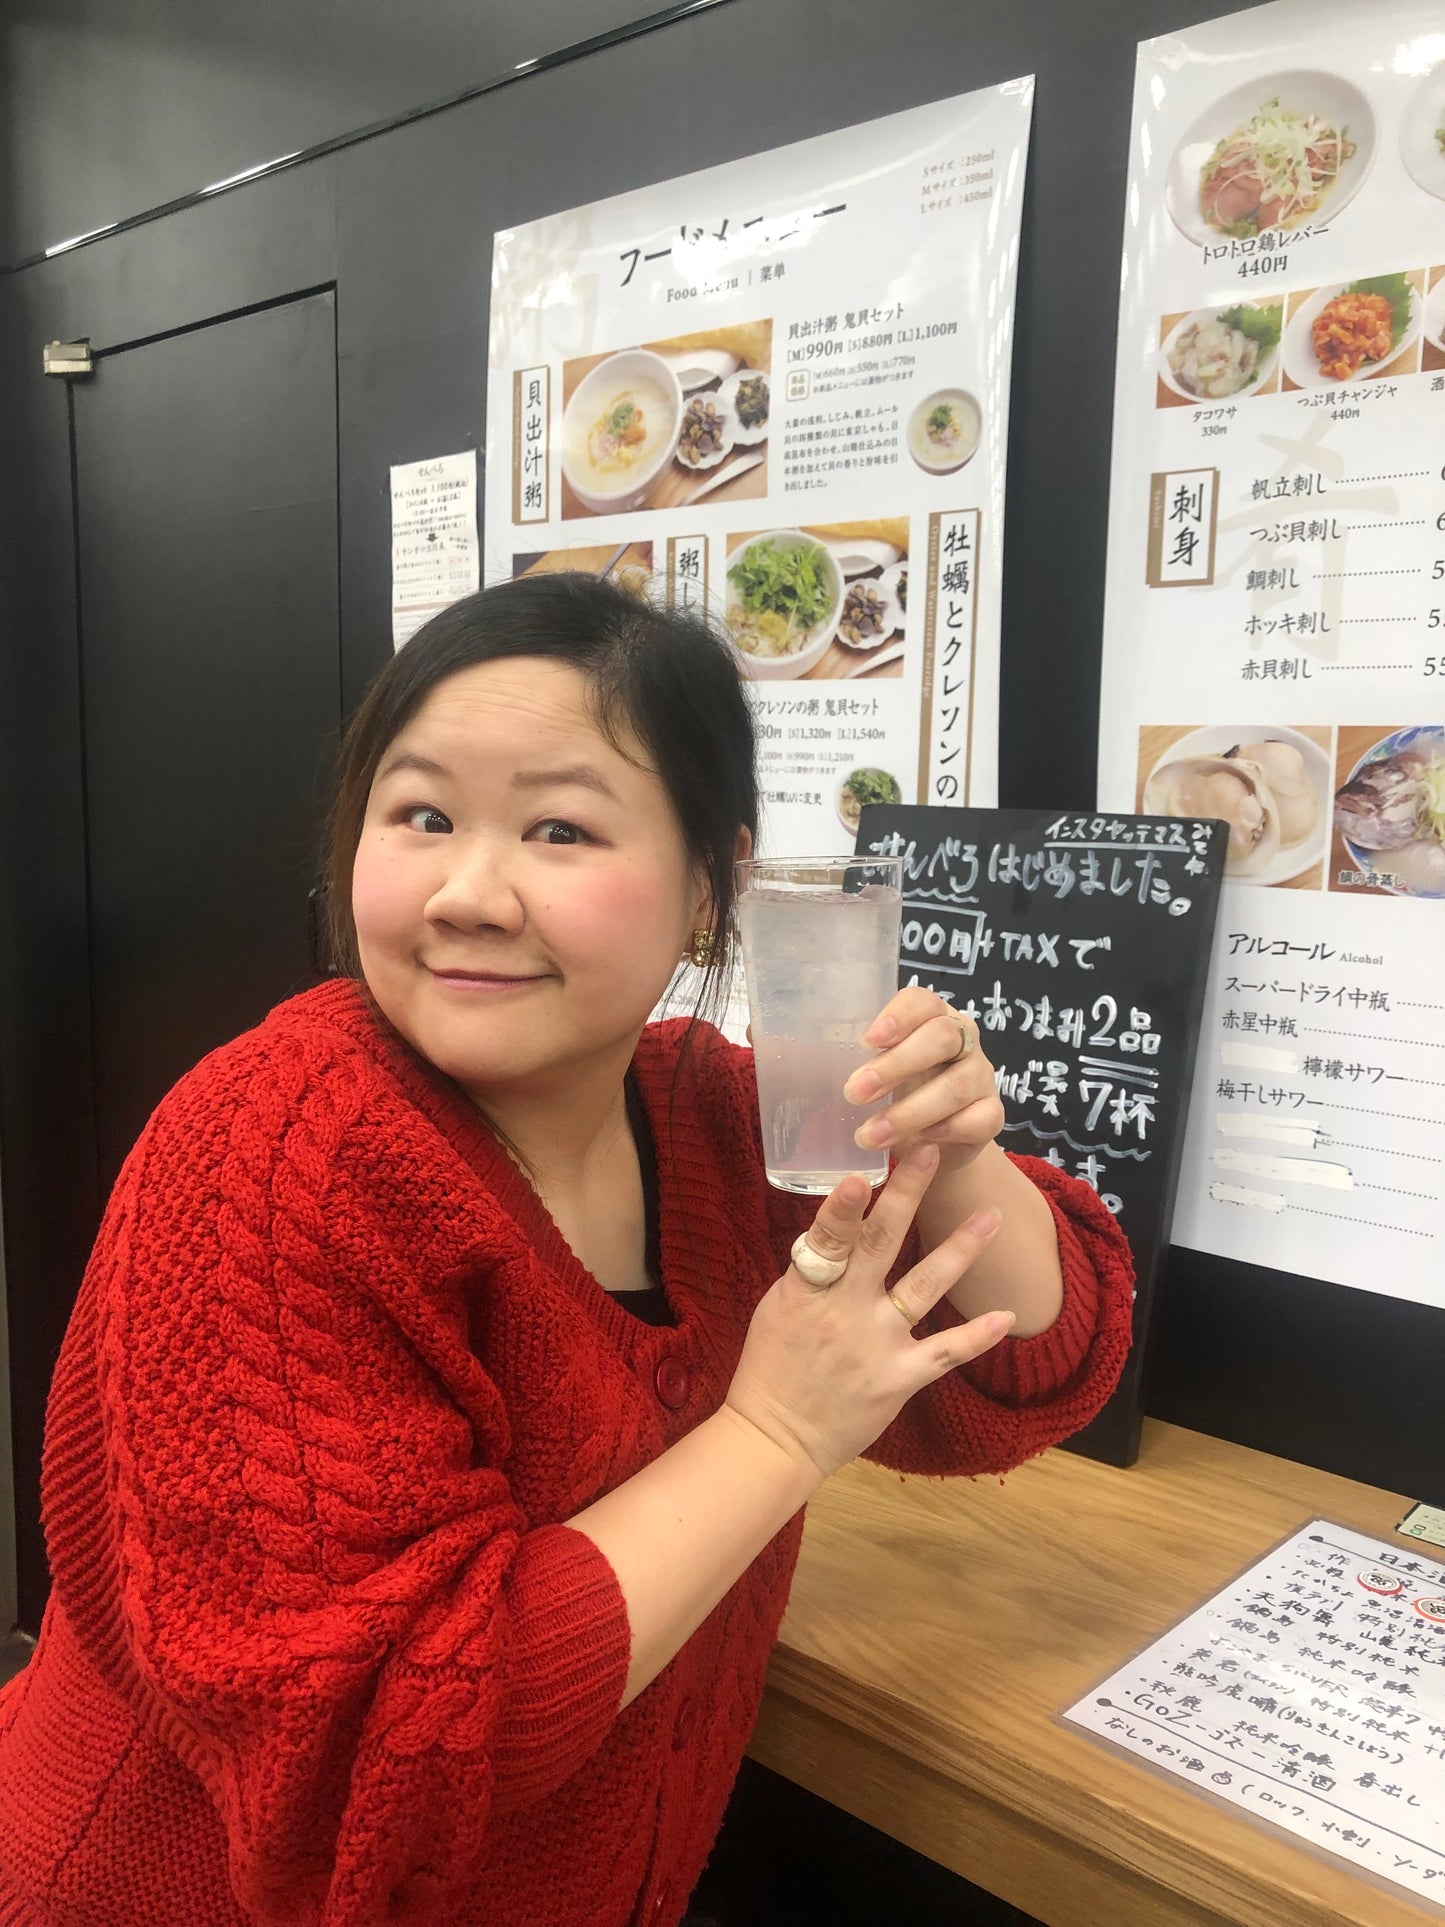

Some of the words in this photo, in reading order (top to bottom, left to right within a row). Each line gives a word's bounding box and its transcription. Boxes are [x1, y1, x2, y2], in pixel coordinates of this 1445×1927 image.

[1203, 225, 1330, 265] トロトロ鶏レバー
[1237, 254, 1288, 278] 440円
[702, 277, 739, 296] nu
[787, 315, 838, 341] 貝出汁粥
[843, 302, 905, 331] 鬼貝セット
[1297, 384, 1398, 408] つぶ貝チャンジャ
[1192, 406, 1238, 424] タコワサ
[1330, 408, 1360, 421] 440円
[523, 379, 543, 509] 貝出汁粥
[1201, 425, 1228, 438] 330円
[1250, 472, 1328, 501] 帆立刺し
[1166, 482, 1205, 567] 刺身
[1249, 517, 1343, 544] つぶ貝刺し
[1245, 567, 1301, 592] 鯛刺し
[1244, 611, 1332, 636] ホッキ刺し
[1241, 656, 1313, 681] 赤貝刺し
[824, 697, 879, 717] 鬼貝セット
[754, 724, 782, 740] 30円
[1228, 932, 1336, 962] アルコール
[1338, 952, 1384, 966] Alcohol
[1224, 974, 1391, 1013] スーパードライ中瓶
[1221, 1009, 1299, 1038] 赤星中瓶
[1302, 1054, 1406, 1085] 檸檬サワー
[1216, 1077, 1325, 1109] 梅干しサワー
